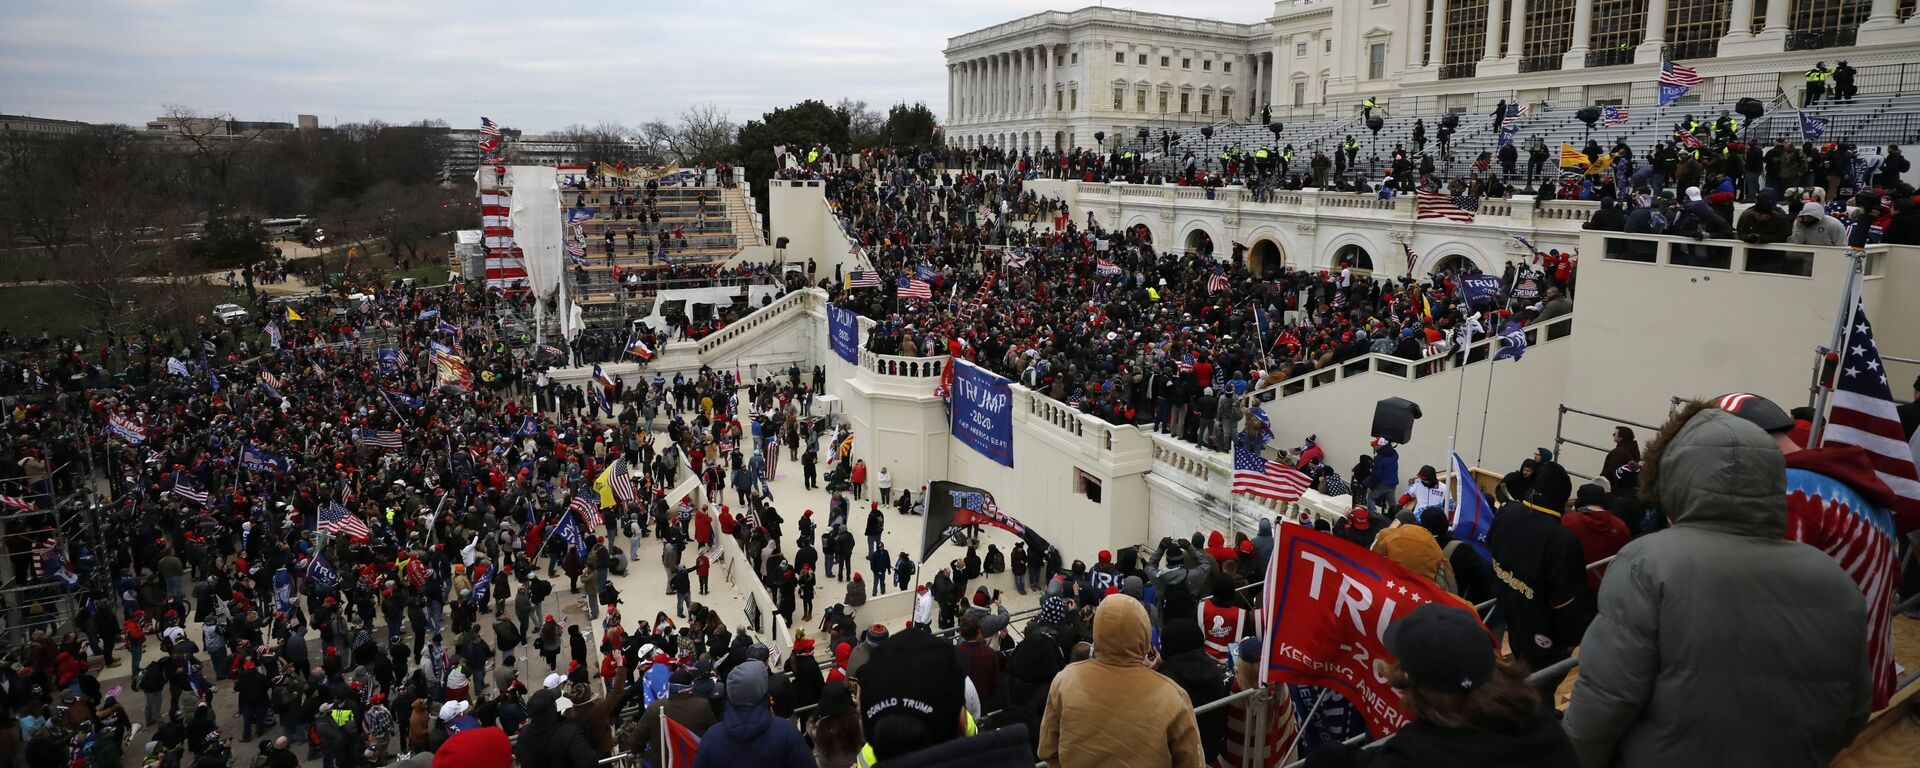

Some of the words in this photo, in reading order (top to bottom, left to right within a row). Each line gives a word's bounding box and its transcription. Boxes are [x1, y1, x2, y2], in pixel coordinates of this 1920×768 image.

[957, 375, 1007, 414] TRUMP
[249, 462, 272, 472] TEXAS
[1279, 642, 1355, 681] KEEPING
[866, 697, 898, 719] DONALD
[902, 697, 934, 715] TRUMP
